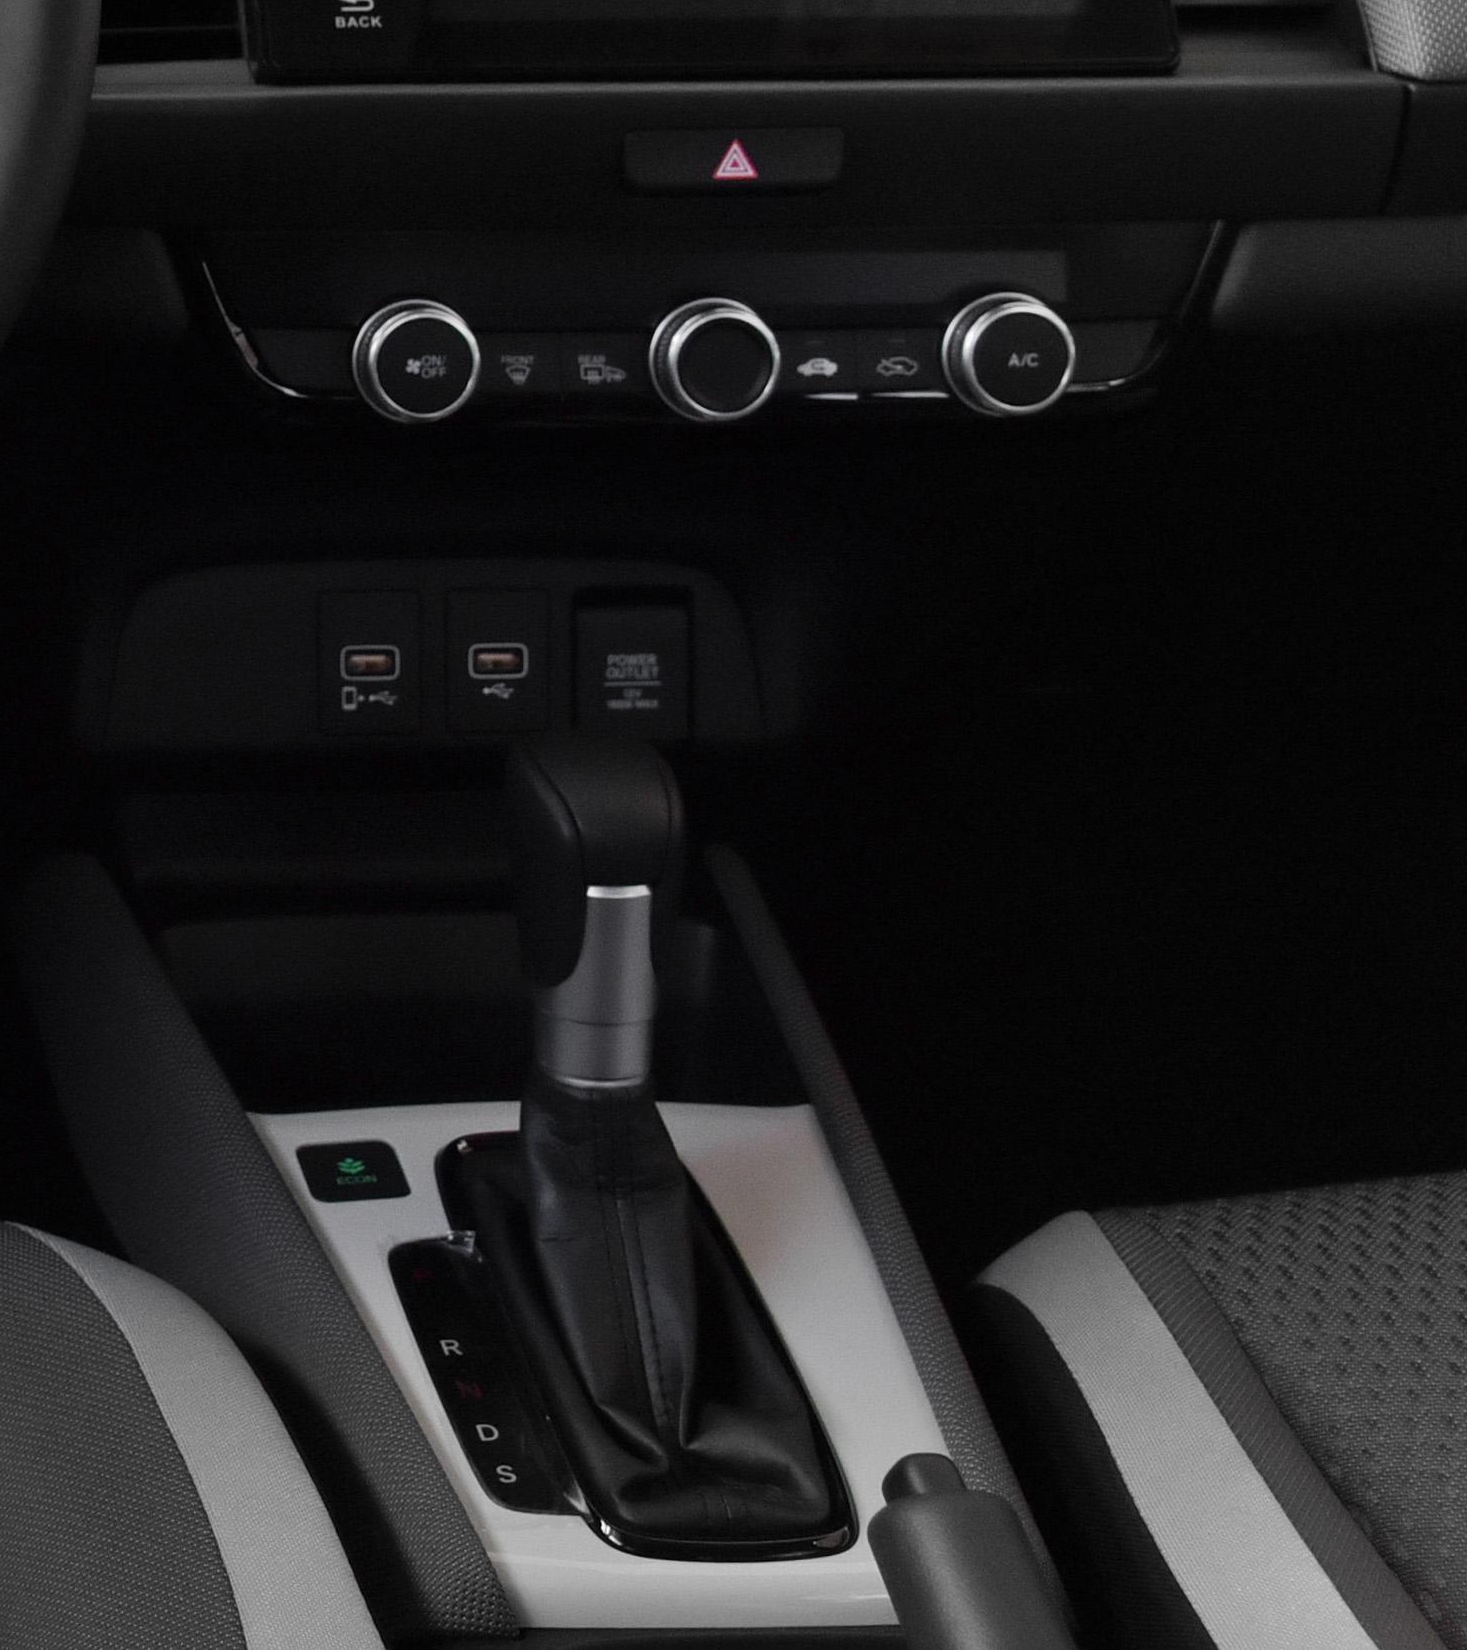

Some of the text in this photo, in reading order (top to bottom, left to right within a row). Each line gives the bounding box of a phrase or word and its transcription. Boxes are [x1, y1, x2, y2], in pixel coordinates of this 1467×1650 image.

[335, 16, 382, 29] BACK
[1007, 352, 1040, 368] A/C
[421, 367, 446, 379] OFF
[607, 653, 658, 666] POWER
[605, 666, 659, 680] OUTLET
[439, 1338, 464, 1357] R
[475, 1423, 500, 1442] D
[495, 1465, 518, 1484] S
